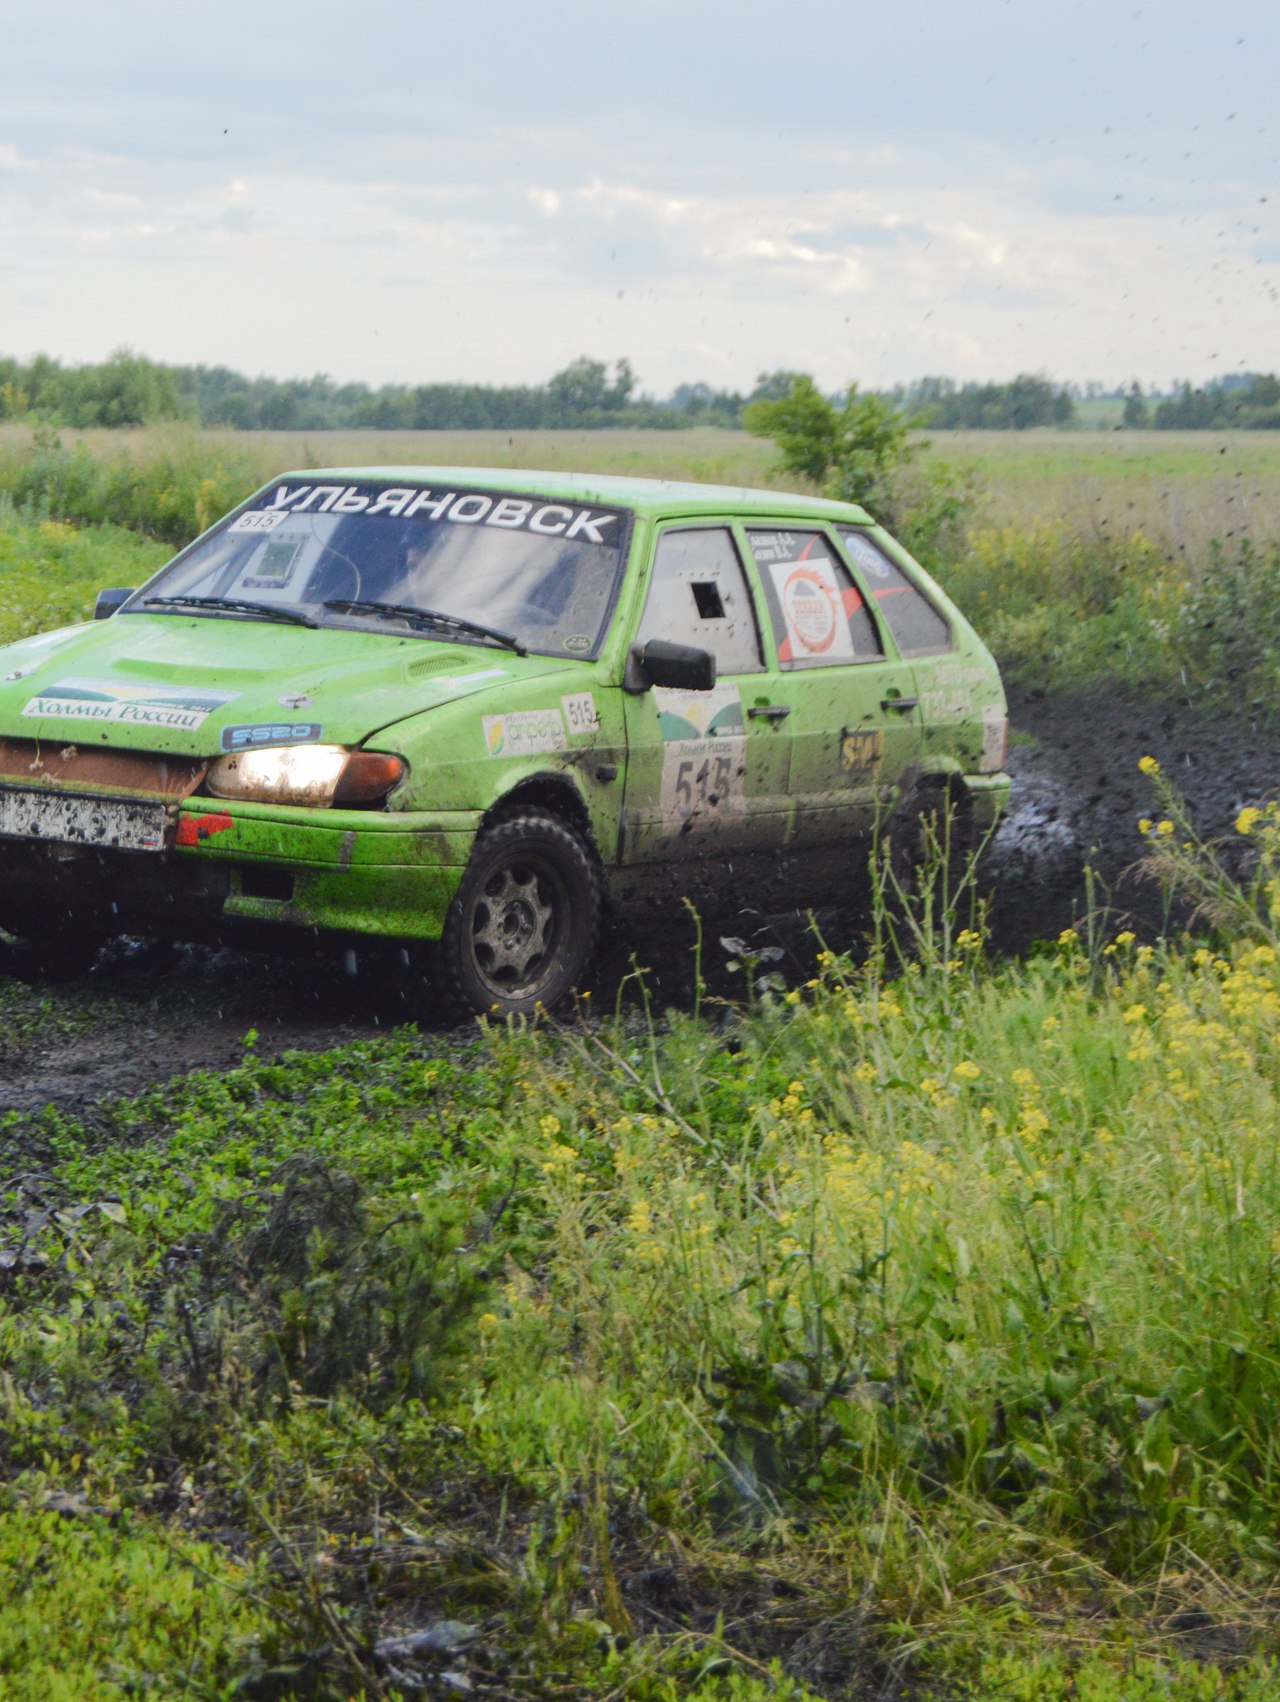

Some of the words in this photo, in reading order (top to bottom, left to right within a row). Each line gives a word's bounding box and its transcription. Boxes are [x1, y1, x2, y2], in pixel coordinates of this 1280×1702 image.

[239, 514, 279, 528] 515
[264, 485, 619, 543] УЛЬЯНОВСК
[29, 699, 112, 716] Холмы
[120, 705, 198, 727] России
[568, 700, 594, 726] 515
[231, 725, 312, 744] SS20
[674, 757, 732, 816] 515
